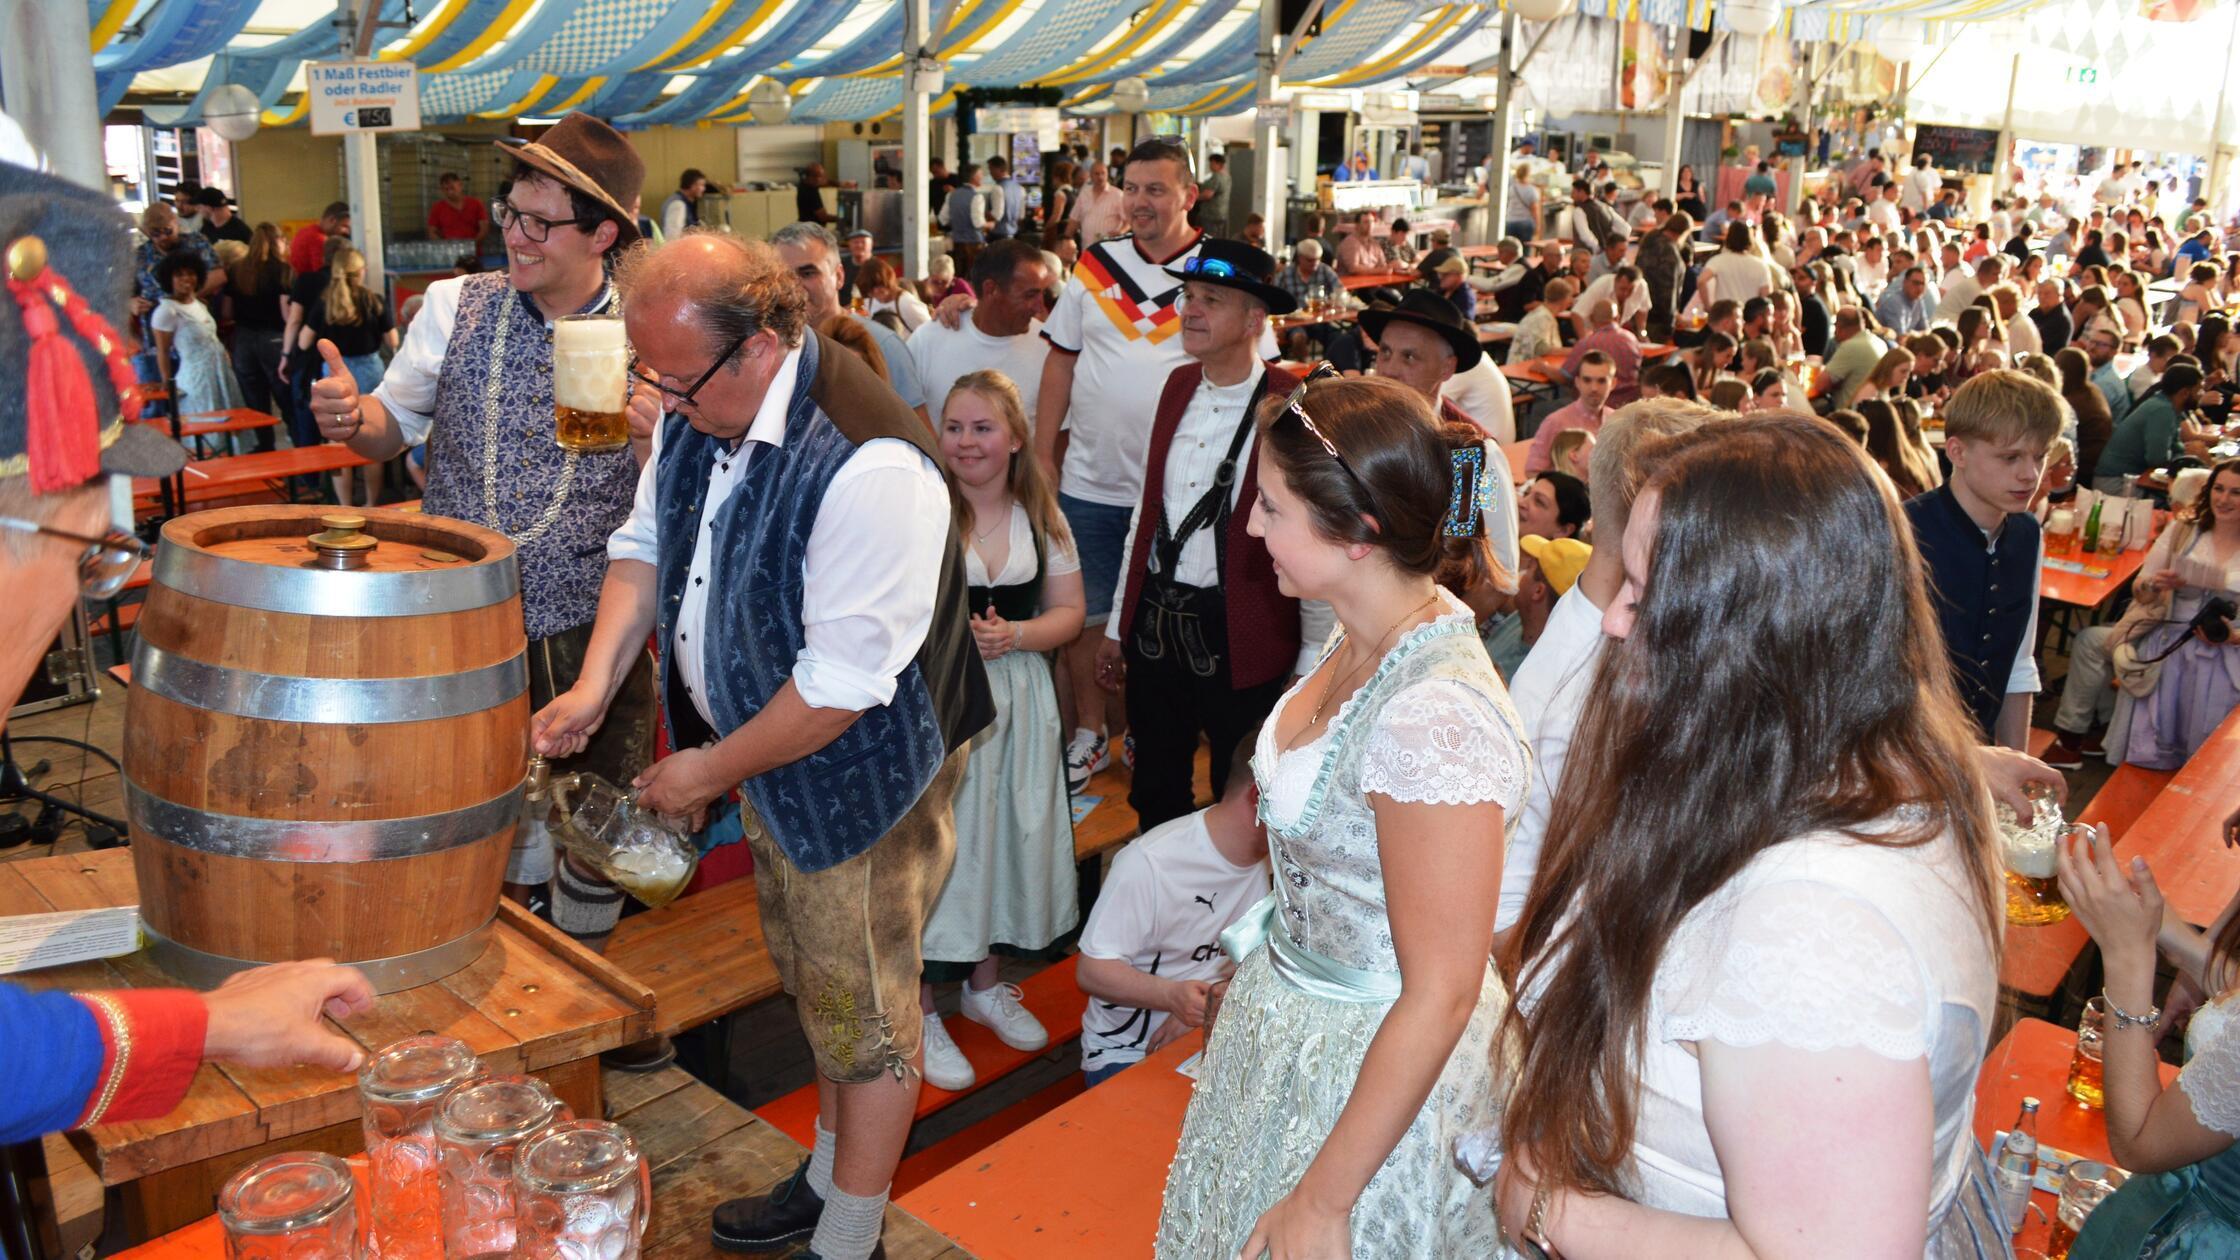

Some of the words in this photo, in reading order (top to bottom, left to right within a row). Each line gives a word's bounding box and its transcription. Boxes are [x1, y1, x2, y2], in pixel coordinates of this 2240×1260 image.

[313, 69, 320, 80] 1
[325, 68, 354, 80] Maß
[358, 66, 411, 79] Festbier
[325, 84, 356, 96] oder
[360, 82, 403, 95] Radler
[343, 112, 355, 126] €
